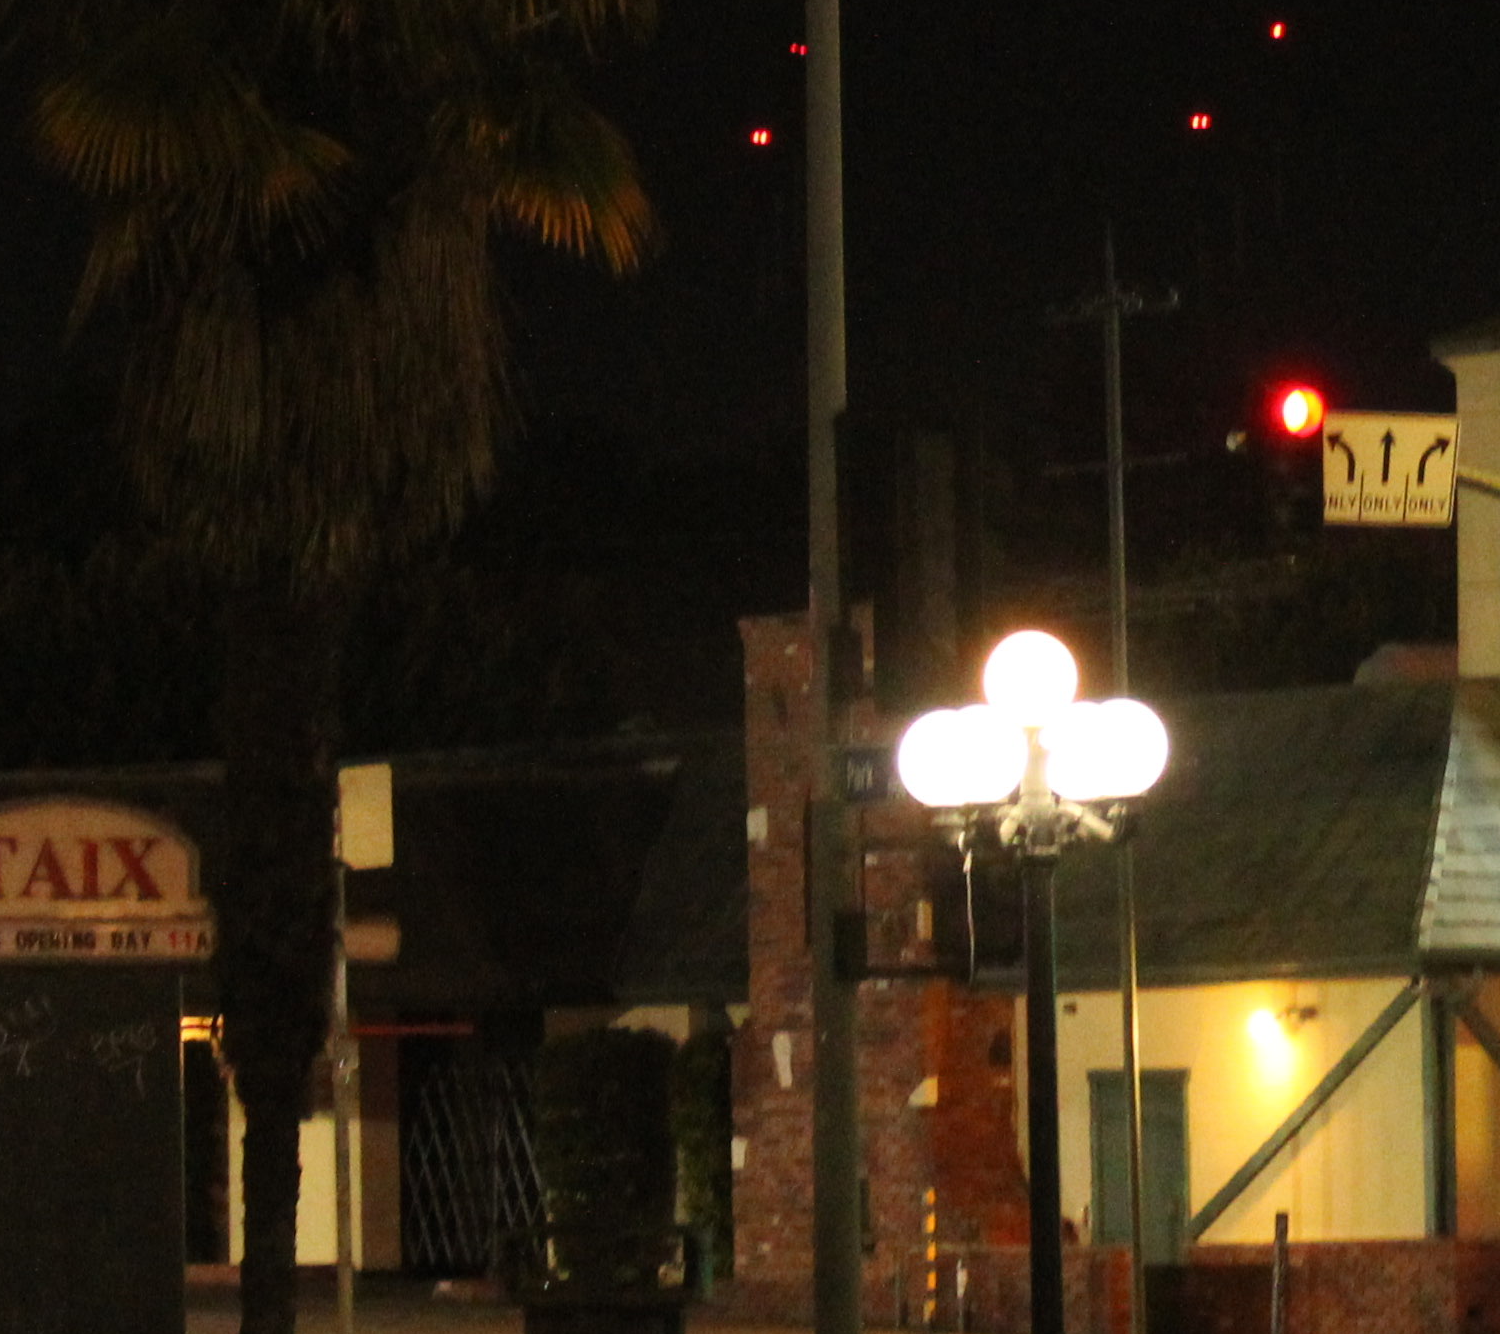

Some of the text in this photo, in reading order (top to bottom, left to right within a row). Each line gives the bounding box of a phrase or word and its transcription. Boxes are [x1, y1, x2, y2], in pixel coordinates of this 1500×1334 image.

[1324, 493, 1446, 512] NLY ONLY ONLY
[15, 930, 96, 952] OPENING
[110, 930, 153, 952] DAY
[167, 930, 209, 952] 11A
